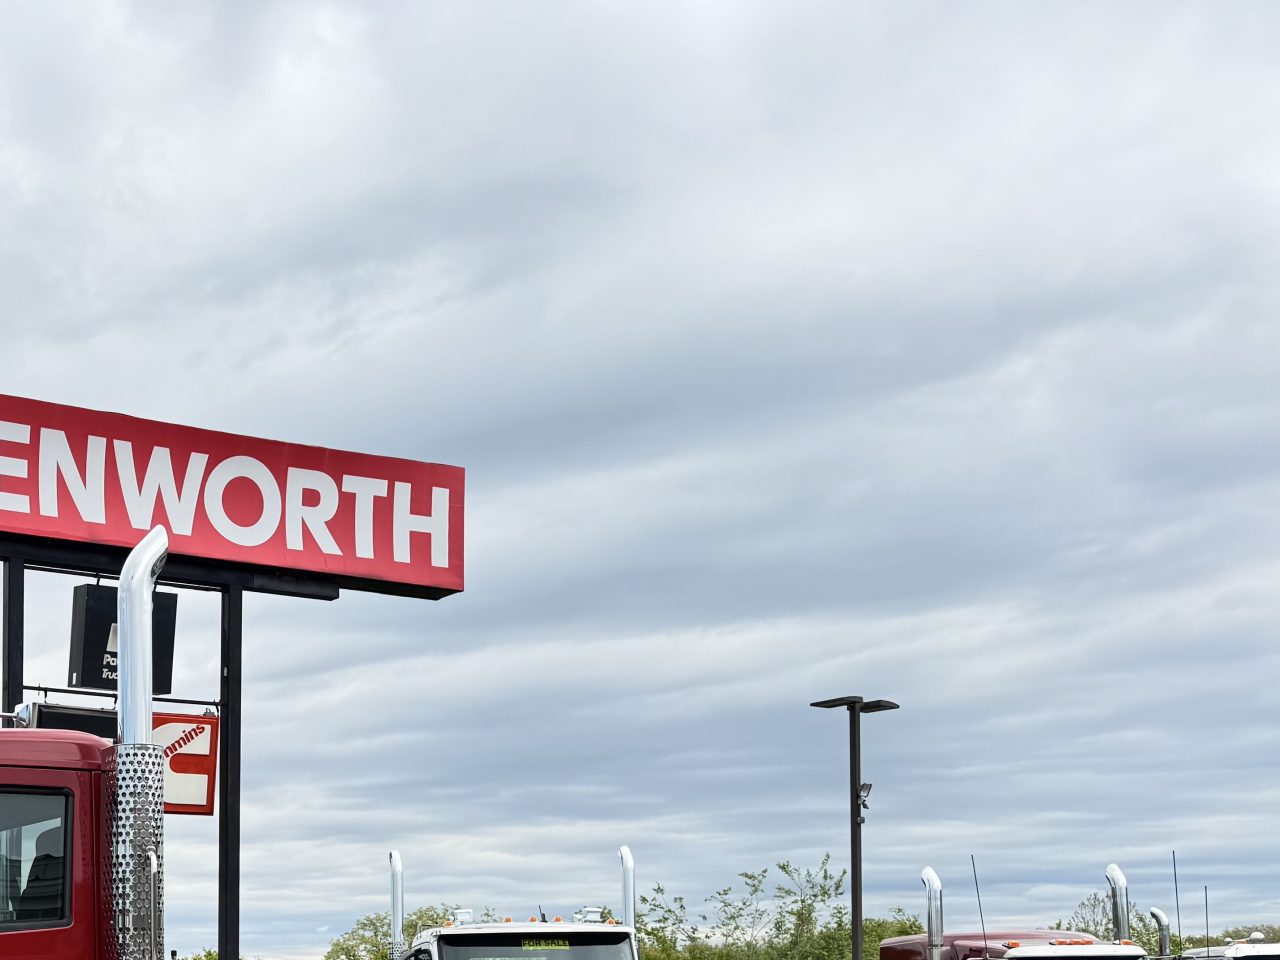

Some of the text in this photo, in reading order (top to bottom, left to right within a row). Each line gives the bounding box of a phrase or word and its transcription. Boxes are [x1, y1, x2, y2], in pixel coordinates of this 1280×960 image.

[163, 724, 205, 759] mmins
[522, 939, 569, 947] FOR SALE
